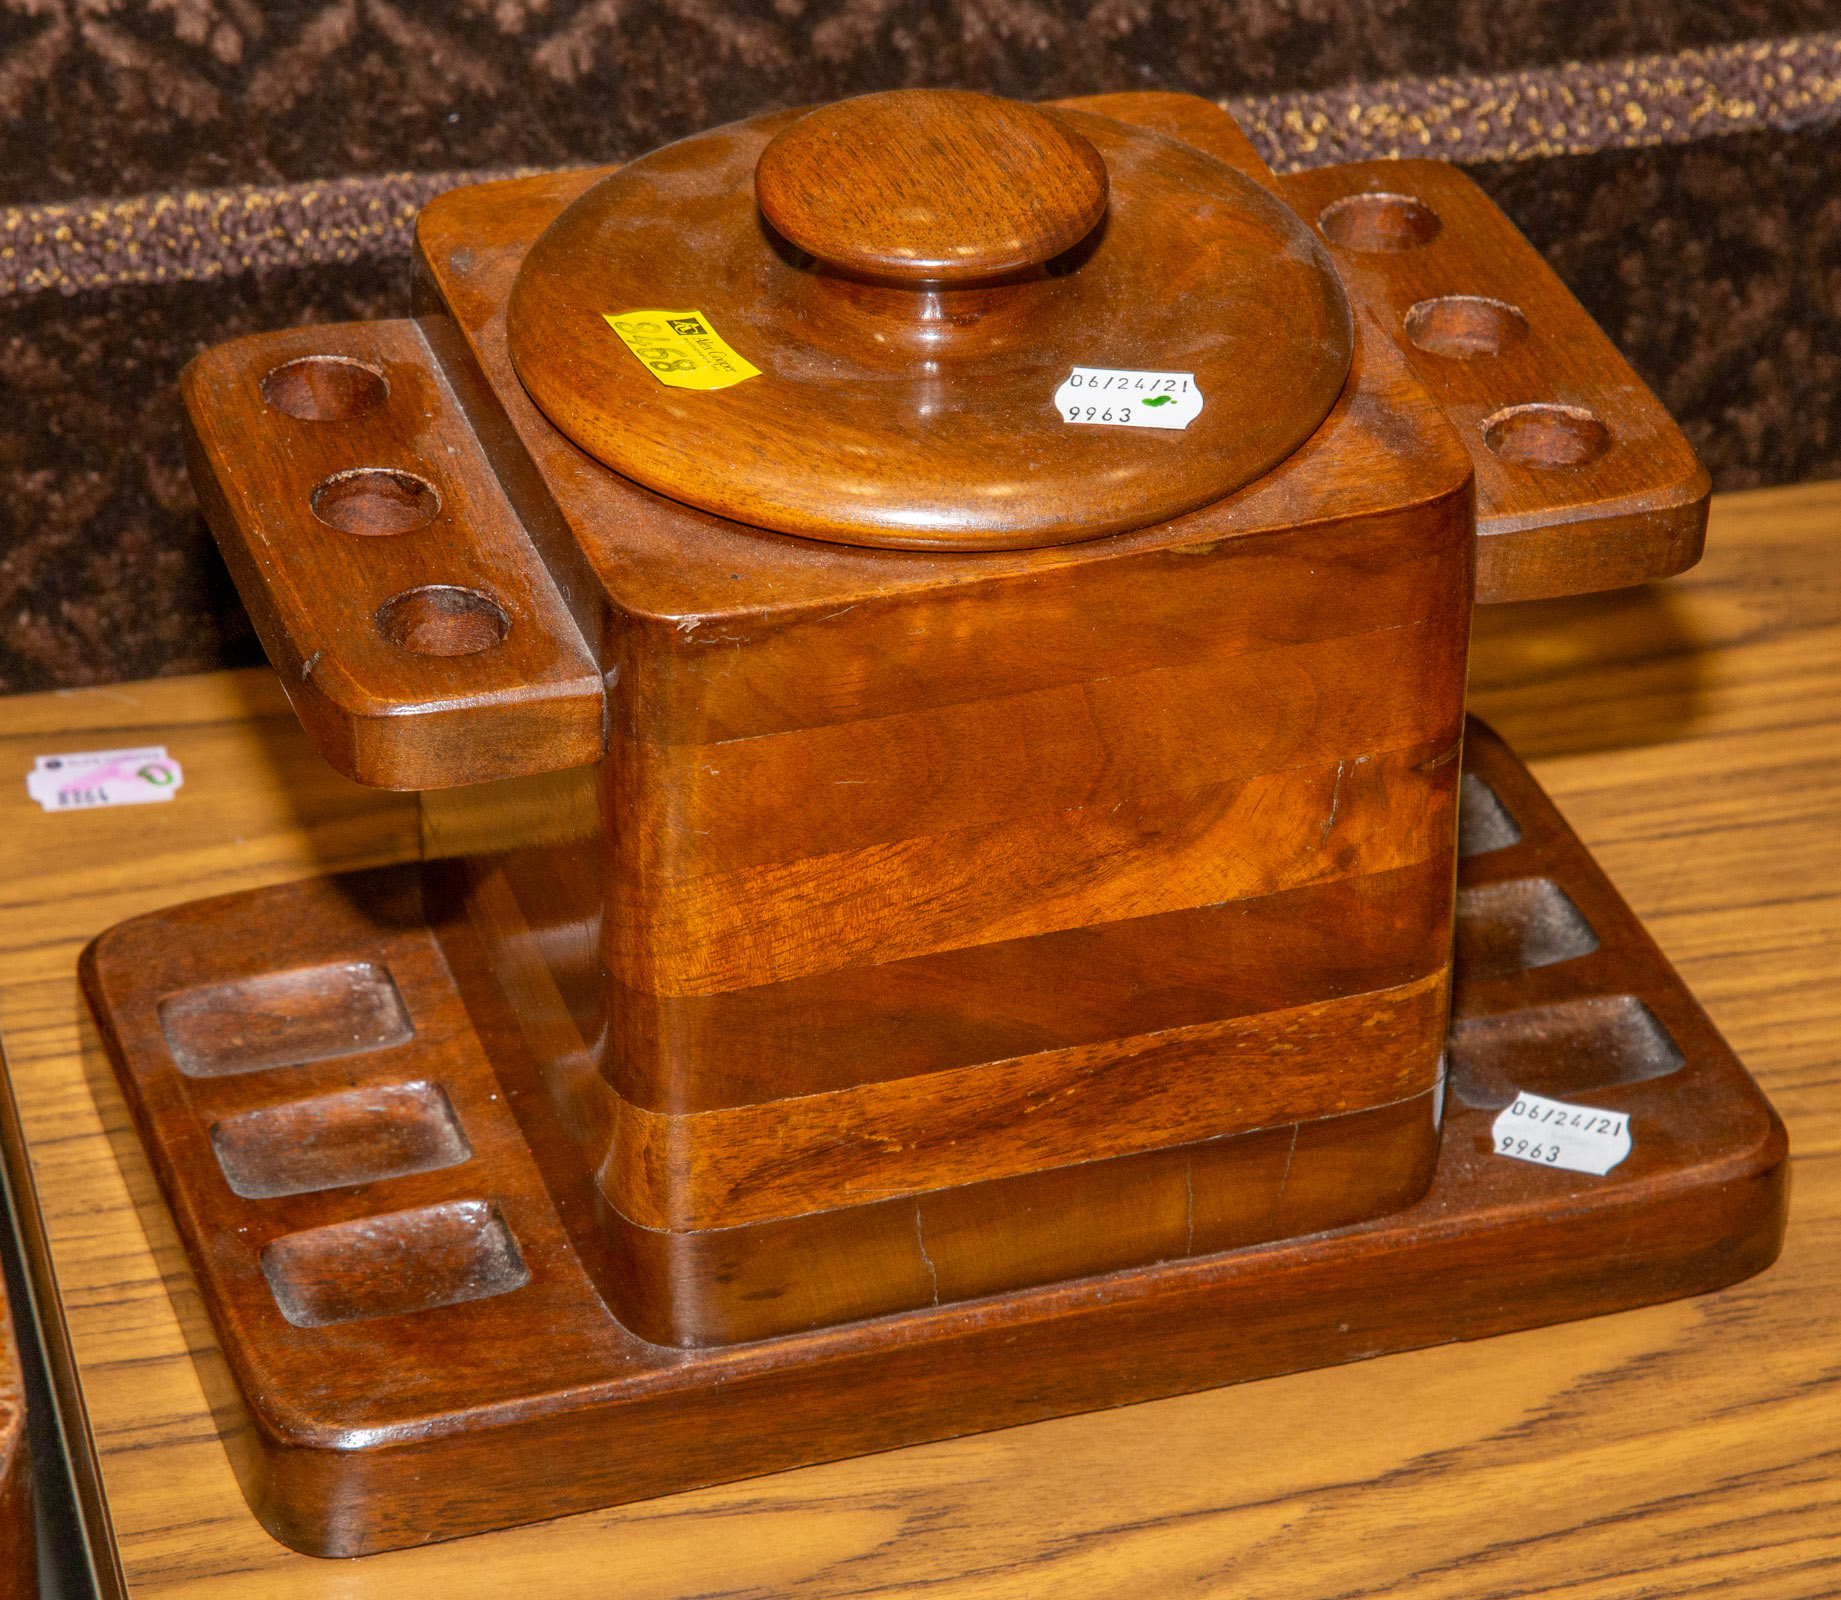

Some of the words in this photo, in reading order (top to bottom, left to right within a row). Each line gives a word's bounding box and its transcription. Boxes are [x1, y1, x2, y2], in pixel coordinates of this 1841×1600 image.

[614, 321, 697, 373] 8468
[1069, 374, 1188, 393] 06/24/21
[1068, 406, 1132, 423] 9963
[1511, 1100, 1622, 1137] 06/24/21
[1501, 1136, 1561, 1163] 9963
